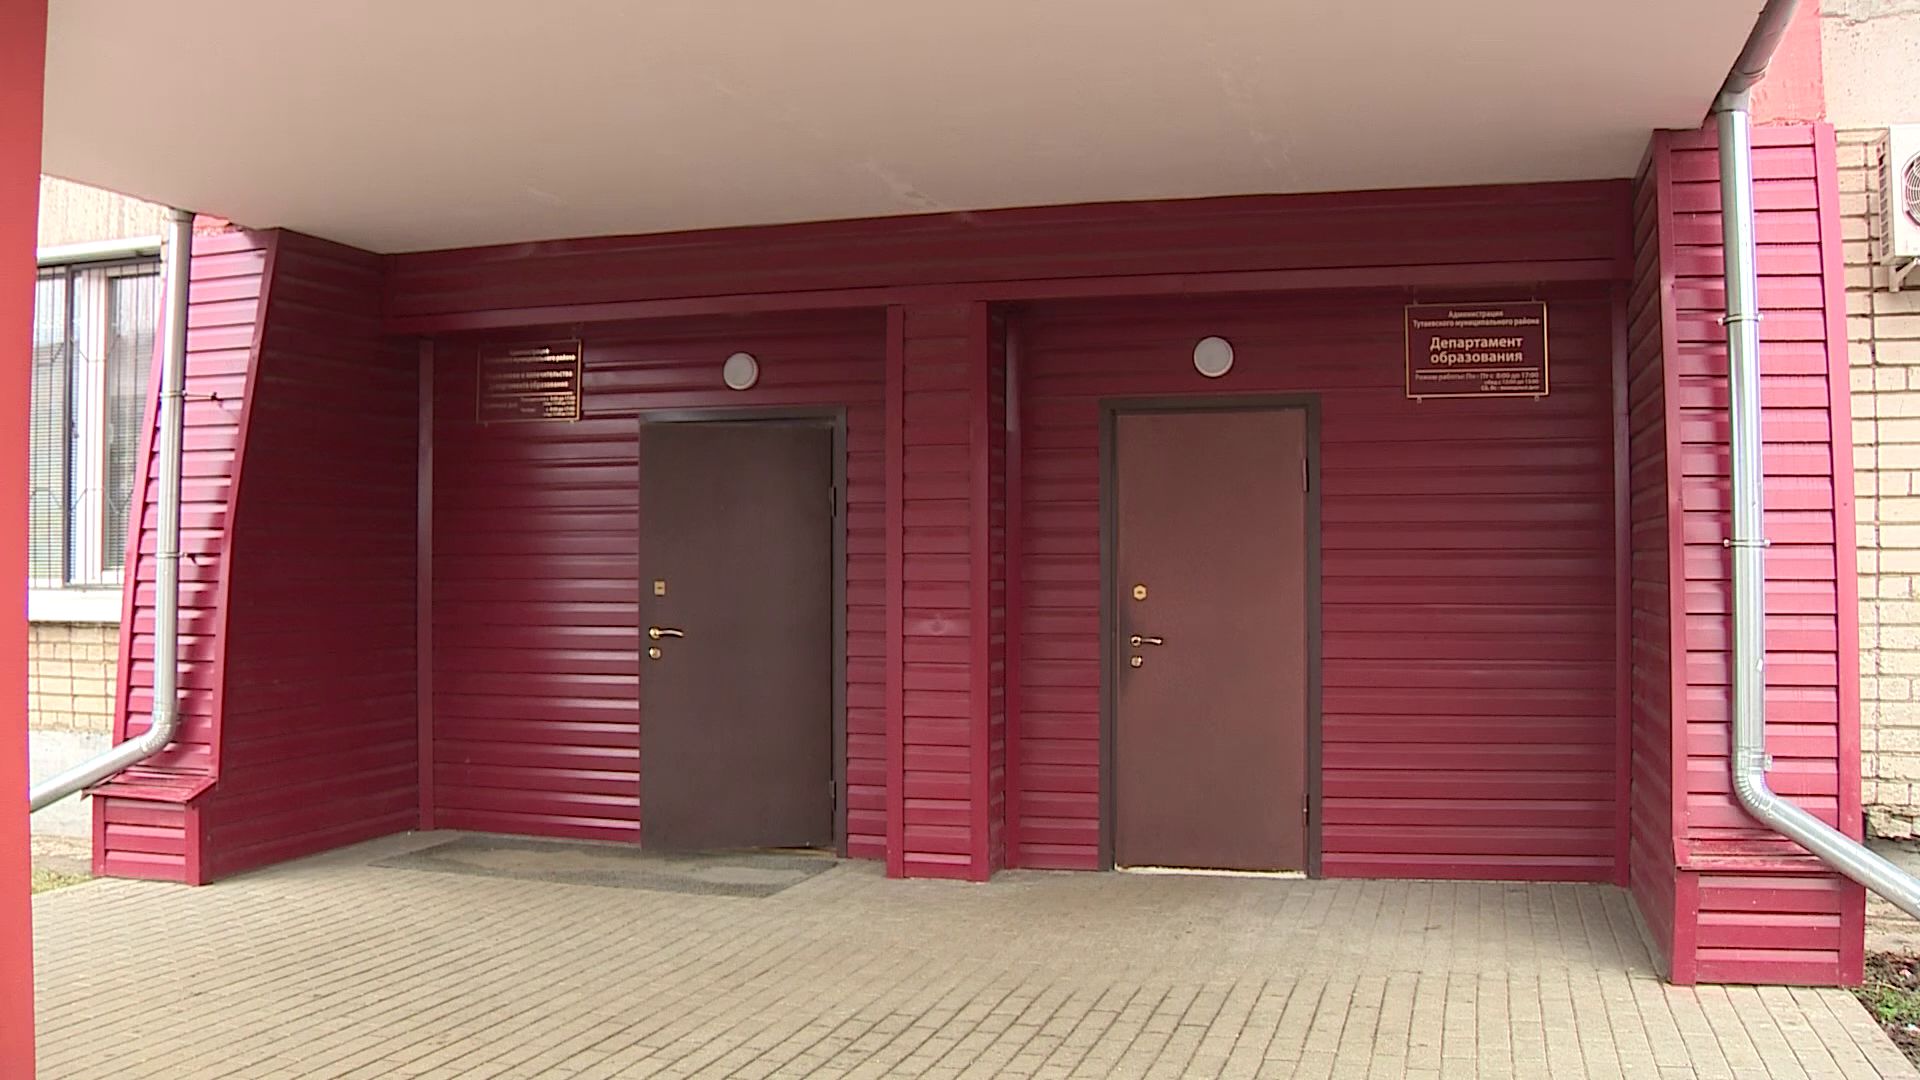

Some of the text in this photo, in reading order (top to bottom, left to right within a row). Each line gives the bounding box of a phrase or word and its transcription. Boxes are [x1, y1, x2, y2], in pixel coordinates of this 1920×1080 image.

[1514, 316, 1539, 326] района
[1430, 336, 1523, 351] Департамент
[1430, 351, 1523, 366] образования
